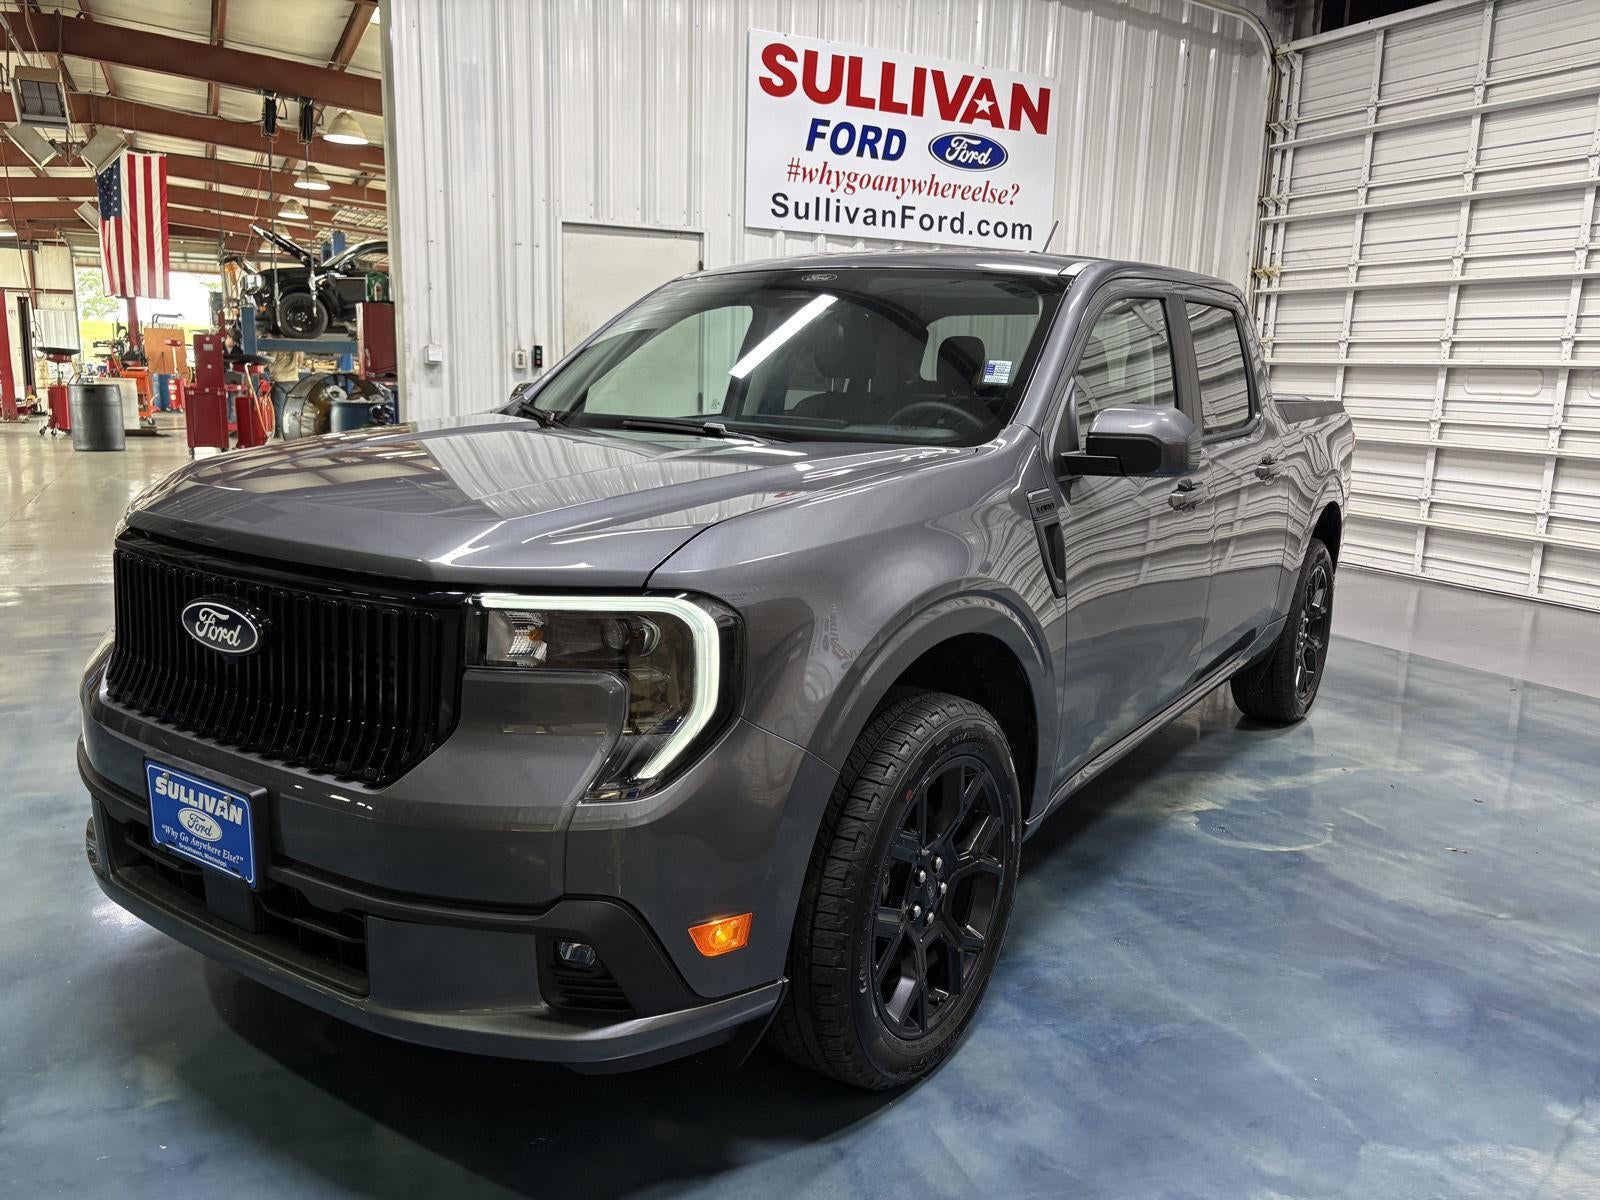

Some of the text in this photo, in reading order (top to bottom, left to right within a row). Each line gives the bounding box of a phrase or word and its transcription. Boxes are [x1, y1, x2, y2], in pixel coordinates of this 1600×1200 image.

[758, 42, 1051, 135] SULLIVAN
[805, 117, 907, 162] FORD
[945, 135, 993, 168] Ford
[787, 156, 1020, 206] #whygoanywhereelse?
[770, 192, 1033, 241] SullivanFord.com
[195, 607, 242, 647] Ford
[155, 776, 243, 825] SULLIVAN
[179, 831, 189, 842] Go
[190, 836, 221, 856] Anywhere
[187, 813, 212, 837] Ford
